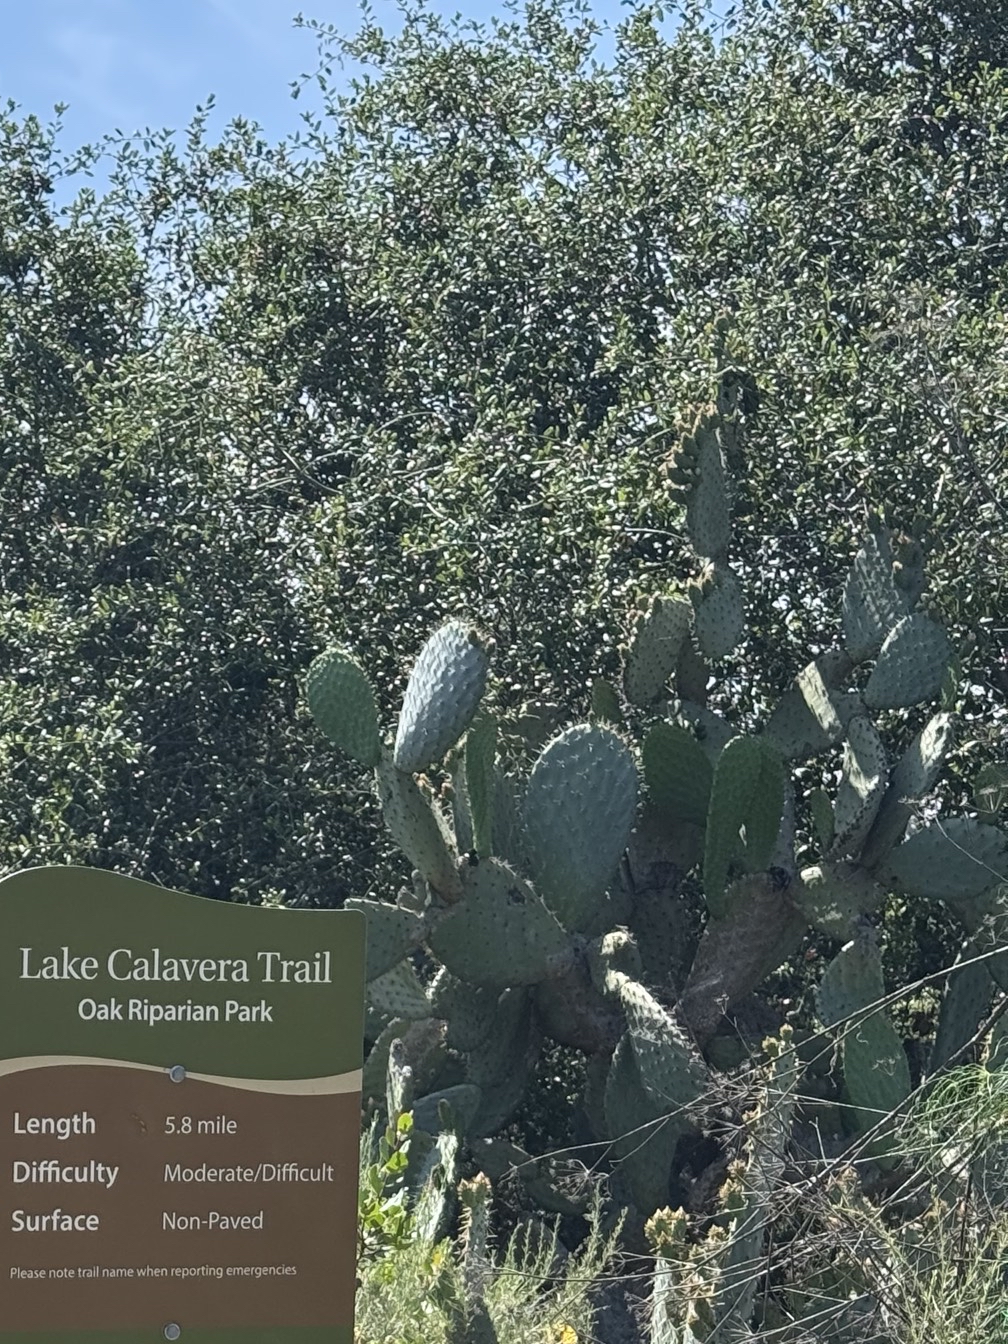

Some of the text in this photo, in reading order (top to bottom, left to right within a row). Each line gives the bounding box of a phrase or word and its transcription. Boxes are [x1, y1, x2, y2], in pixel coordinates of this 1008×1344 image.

[19, 946, 332, 983] Lake Calavera Trail
[78, 998, 273, 1026] Oak Riparian Park
[13, 1112, 237, 1140] Length 5.8 mile
[12, 1160, 334, 1189] Difficulty Moderate/Difficult
[11, 1208, 264, 1232] Surface Non-Paved
[10, 1264, 297, 1279] Please note trail name when reporting emergencies
